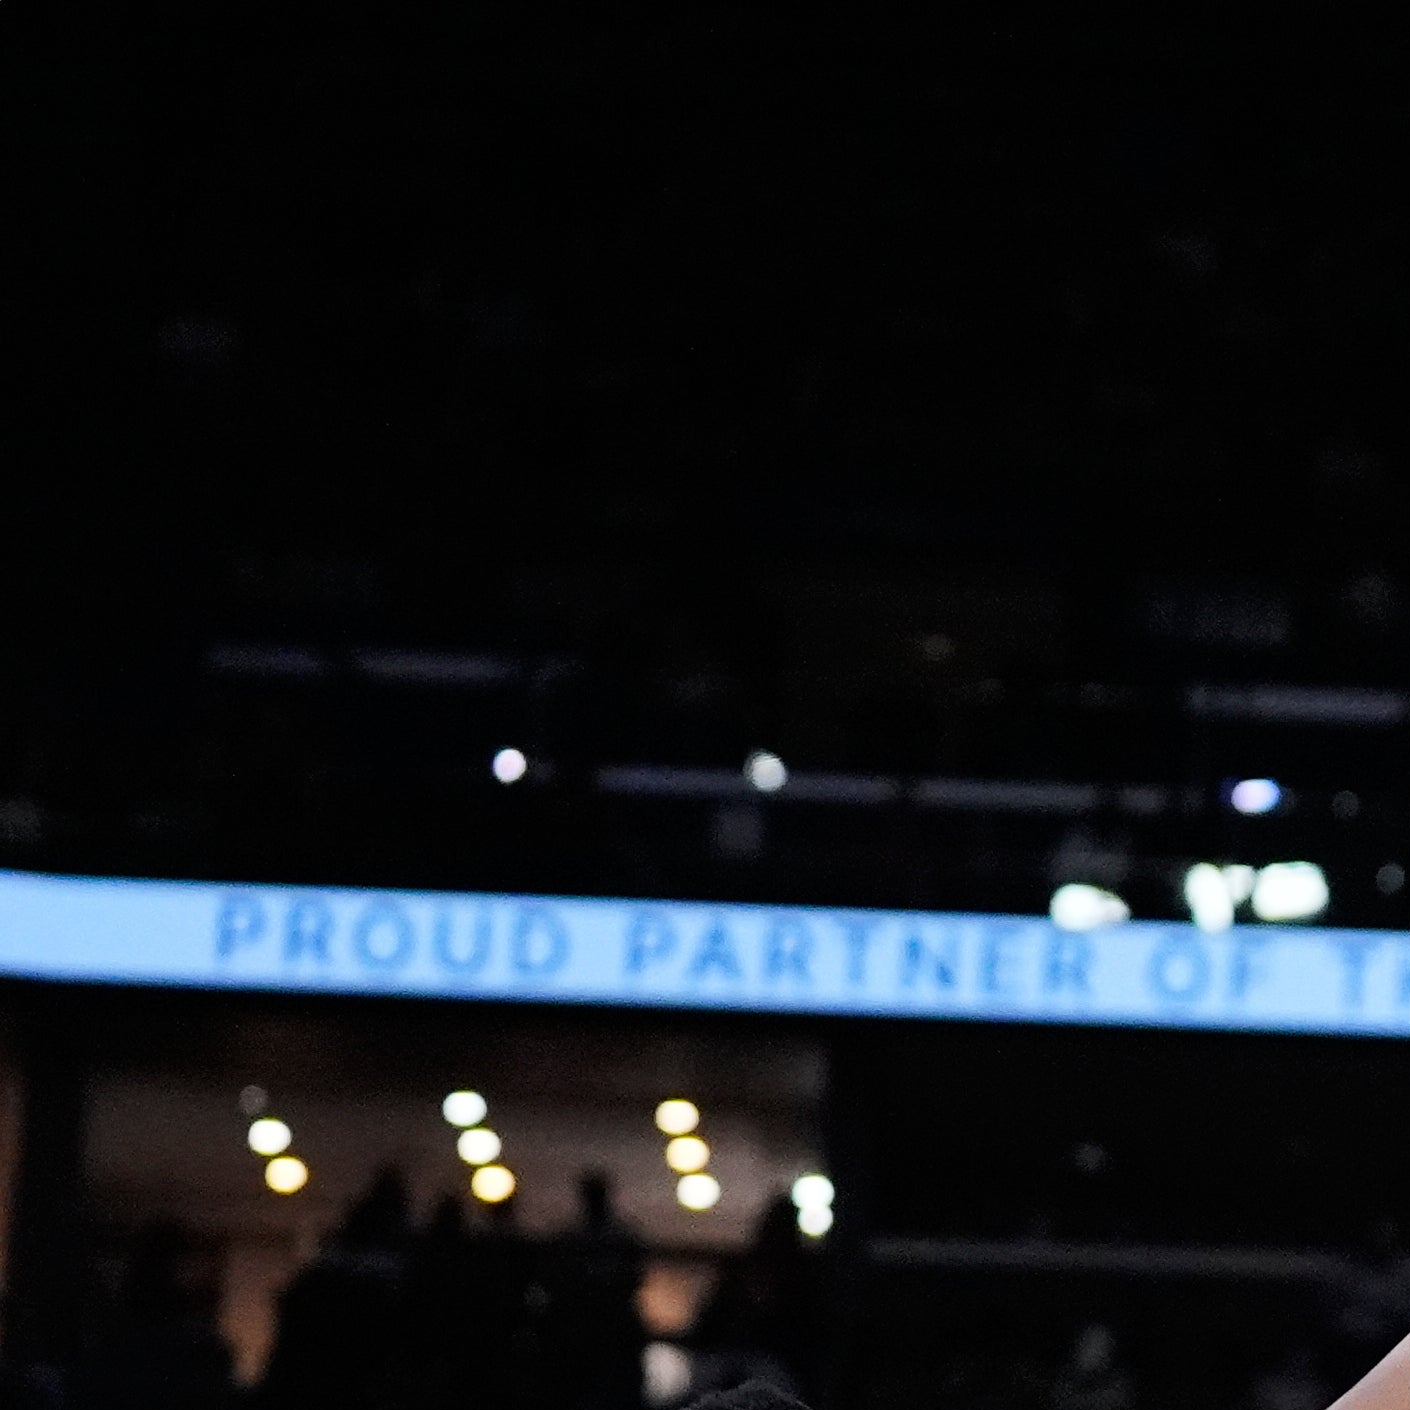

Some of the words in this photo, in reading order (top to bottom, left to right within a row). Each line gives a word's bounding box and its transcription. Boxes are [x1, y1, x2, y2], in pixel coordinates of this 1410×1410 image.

[213, 892, 572, 977] PROUD
[625, 909, 1094, 993] PARTNER
[1147, 934, 1261, 1001] OF
